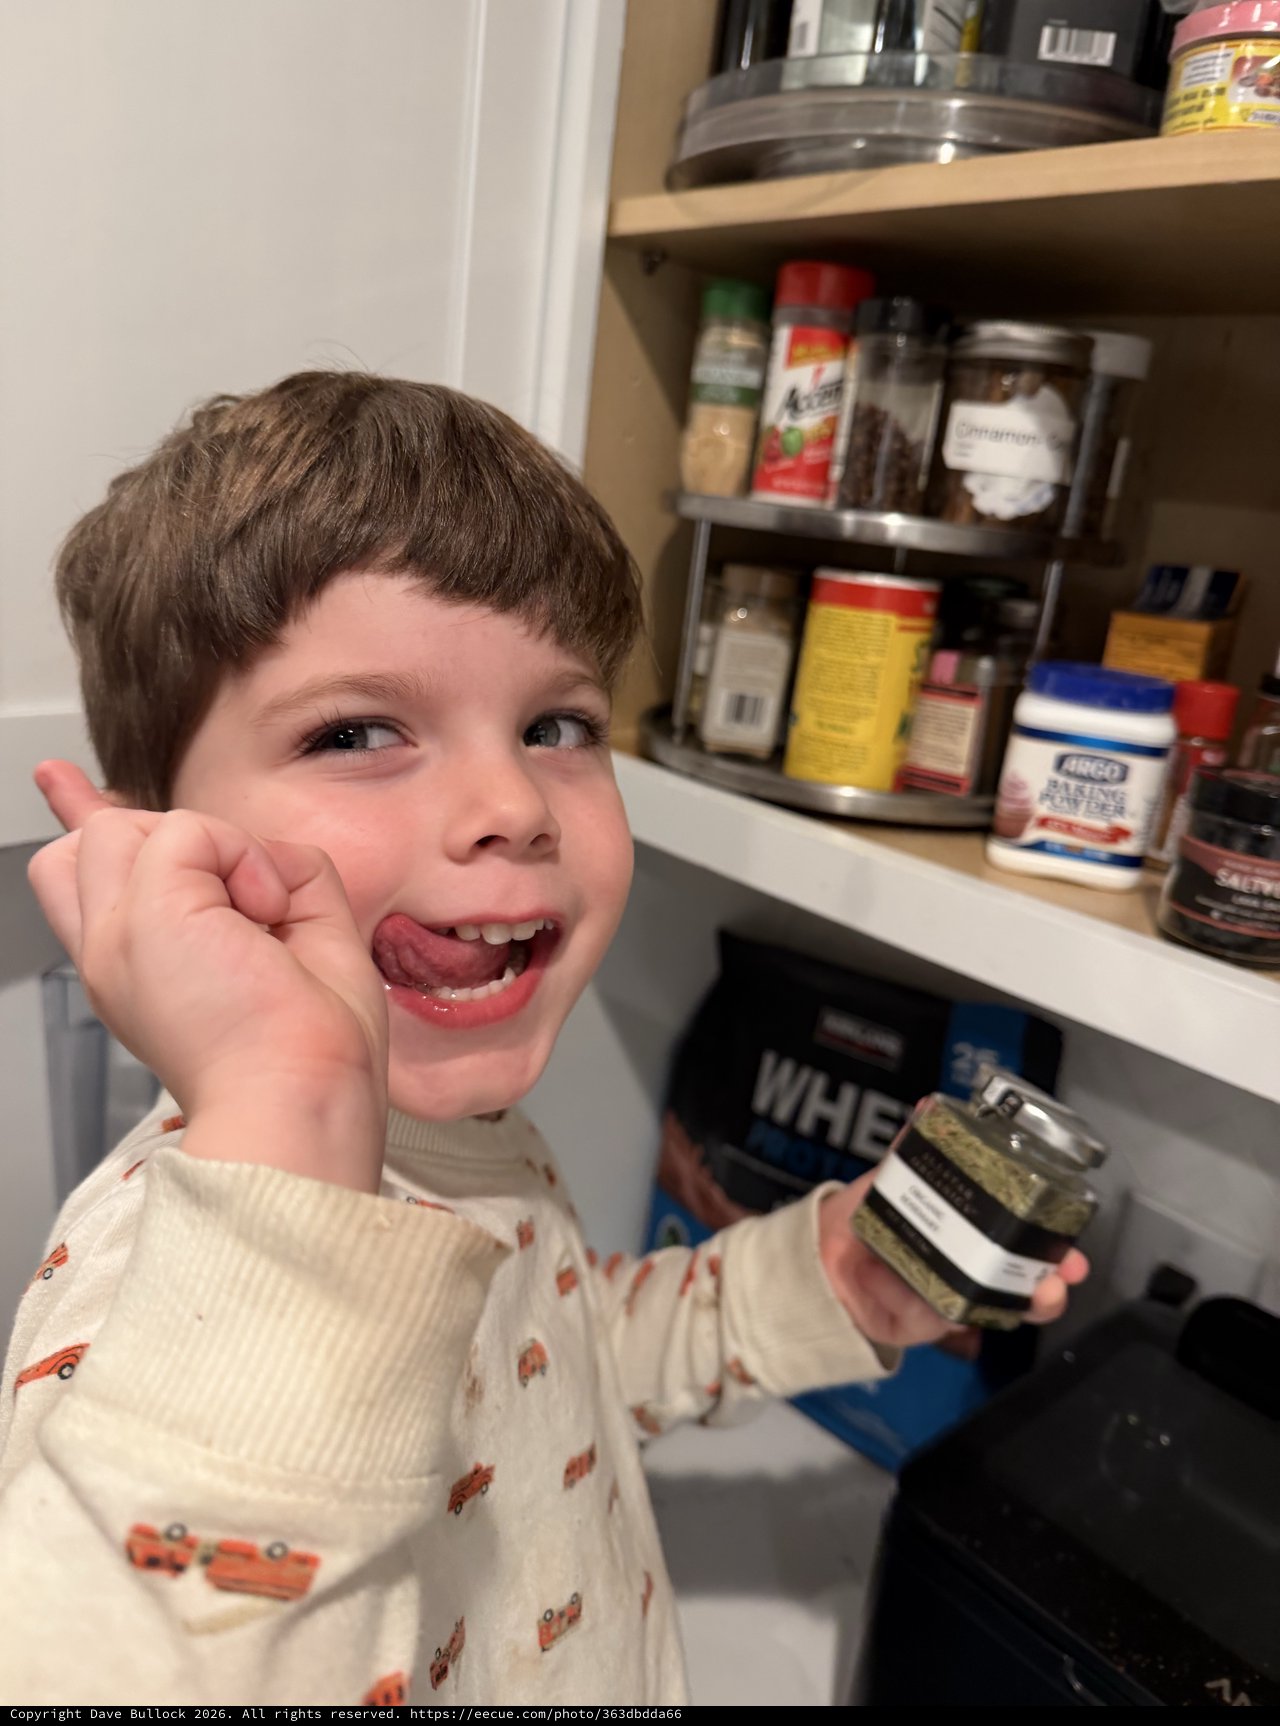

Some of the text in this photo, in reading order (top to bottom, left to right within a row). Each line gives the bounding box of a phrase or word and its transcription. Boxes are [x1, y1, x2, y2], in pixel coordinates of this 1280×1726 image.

[1060, 756, 1122, 783] ARGO
[1047, 779, 1127, 803] BAKING
[1039, 791, 1126, 820] POWDER
[751, 1047, 914, 1163] WHE
